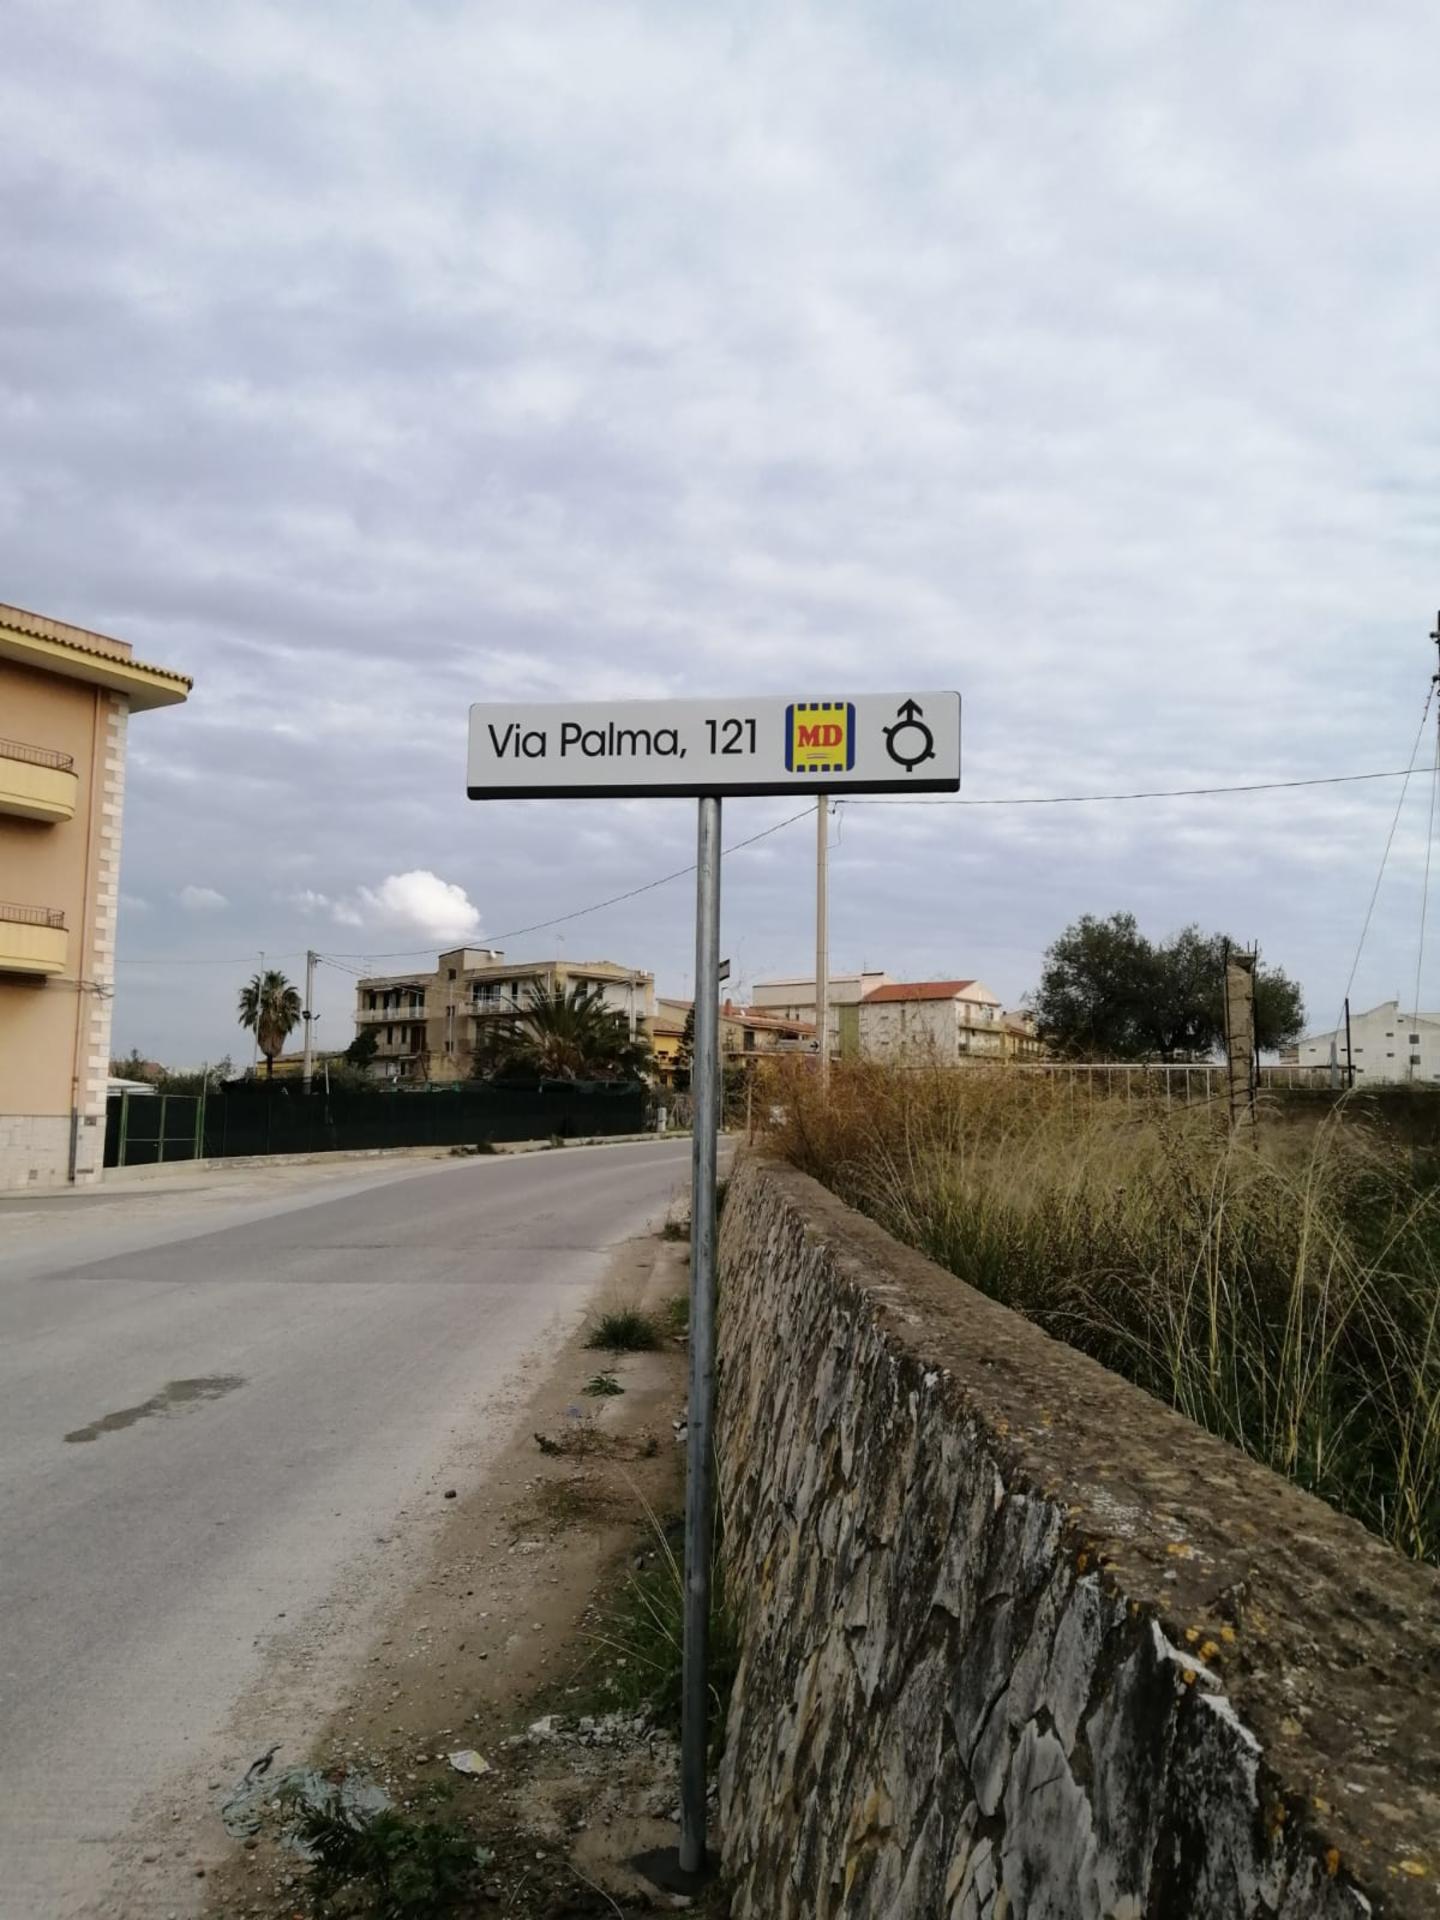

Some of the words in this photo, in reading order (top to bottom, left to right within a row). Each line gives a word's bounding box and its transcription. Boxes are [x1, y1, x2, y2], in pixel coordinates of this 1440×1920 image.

[487, 722, 547, 759] Via
[560, 721, 687, 759] Palma,
[704, 718, 757, 755] 121
[797, 724, 843, 748] MD
